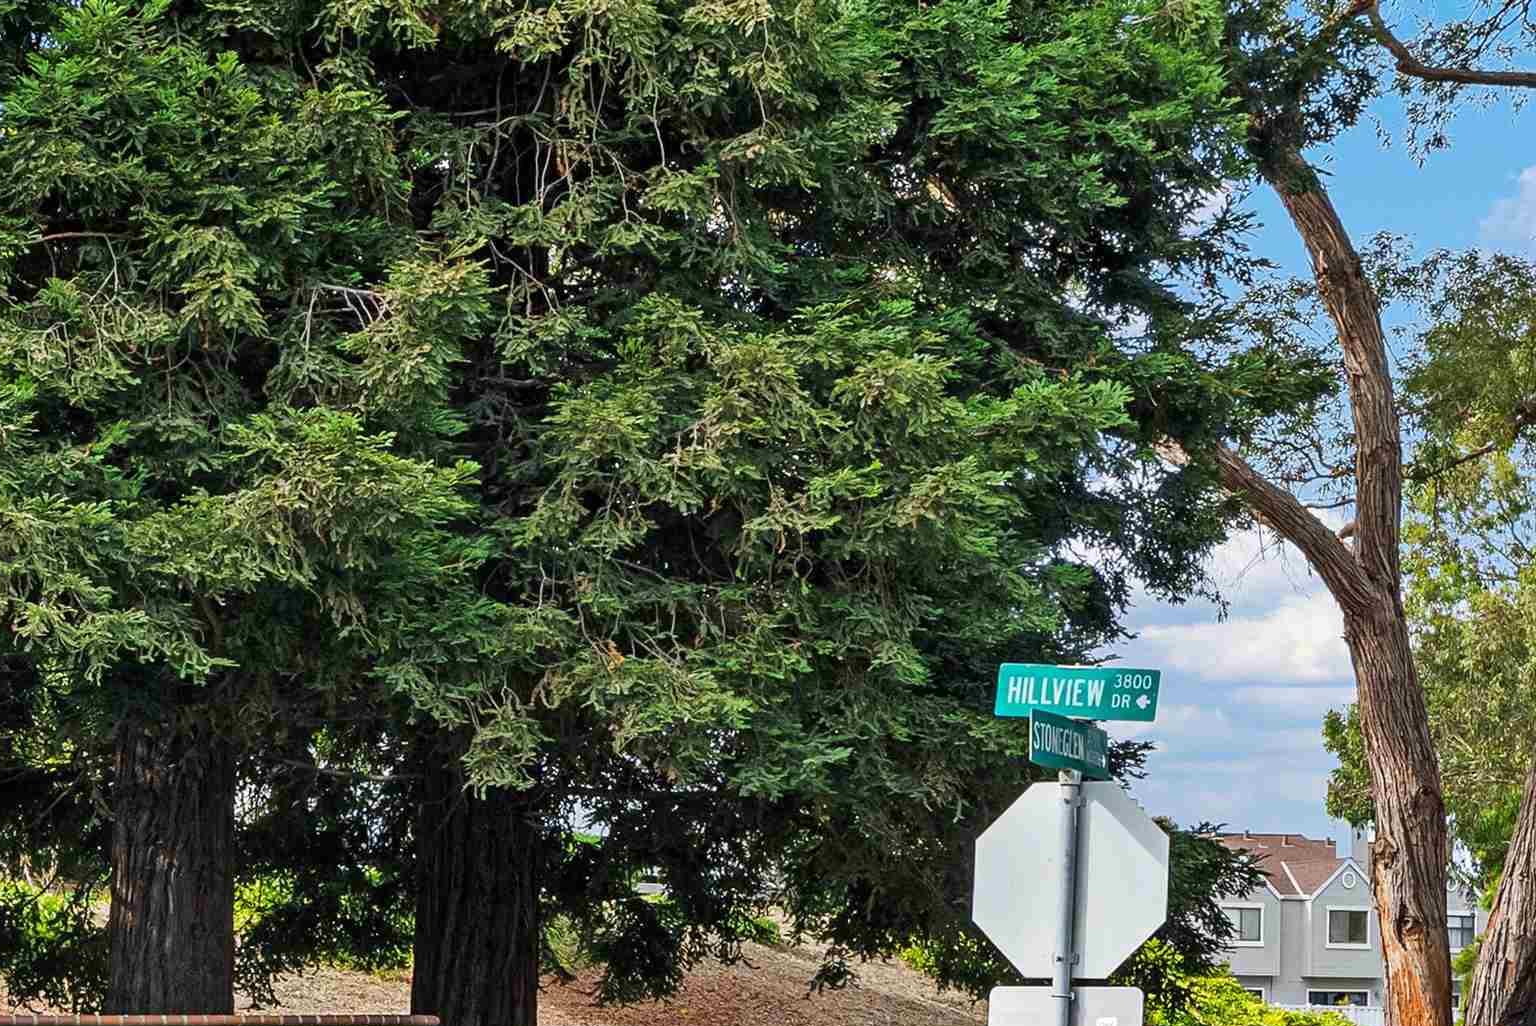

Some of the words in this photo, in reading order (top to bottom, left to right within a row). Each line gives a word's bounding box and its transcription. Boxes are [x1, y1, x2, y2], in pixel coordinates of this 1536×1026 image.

[1007, 676, 1105, 707] HILLVIEW
[1114, 674, 1152, 690] 3800
[1112, 694, 1130, 709] DR
[1033, 721, 1084, 761] STONEGLEN
